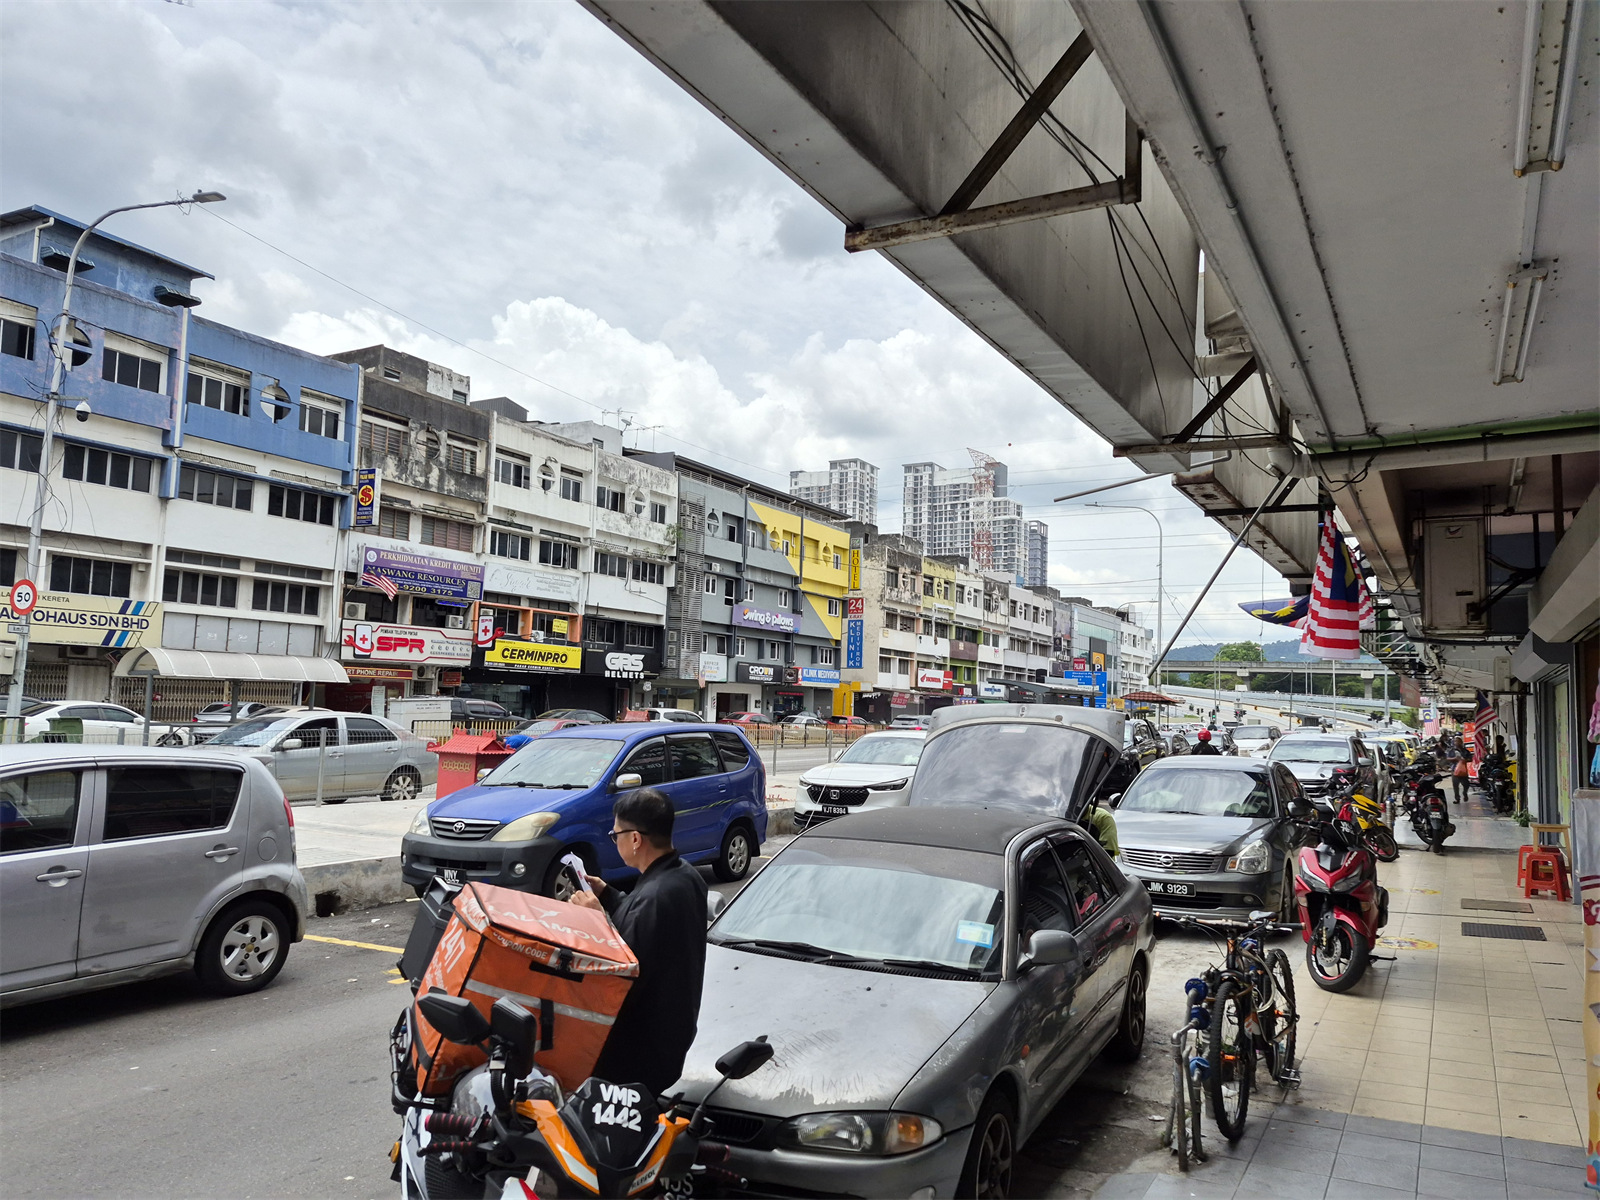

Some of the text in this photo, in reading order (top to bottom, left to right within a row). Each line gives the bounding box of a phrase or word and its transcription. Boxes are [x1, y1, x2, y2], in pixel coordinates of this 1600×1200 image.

[380, 551, 429, 567] PERKHIDMATAN
[429, 559, 452, 569] KREDIT
[453, 562, 482, 574] KOMUNITI
[852, 550, 860, 589] HOTEL
[417, 572, 466, 587] RESOURCES
[16, 592, 31, 602] 50
[41, 595, 70, 603] KERETA
[431, 588, 453, 596] 3175
[849, 599, 863, 610] 24
[0, 606, 150, 630] AUOHAUS SDN BHD
[376, 636, 425, 654] SPR
[848, 621, 856, 667] KLINIK
[501, 647, 568, 664] CERMINPRO
[604, 670, 645, 679] HELMETS
[1147, 881, 1188, 895] JMK 9129
[493, 930, 548, 960] COUPON CODE
[600, 1083, 641, 1108] VMP
[592, 1102, 642, 1132] 1442
